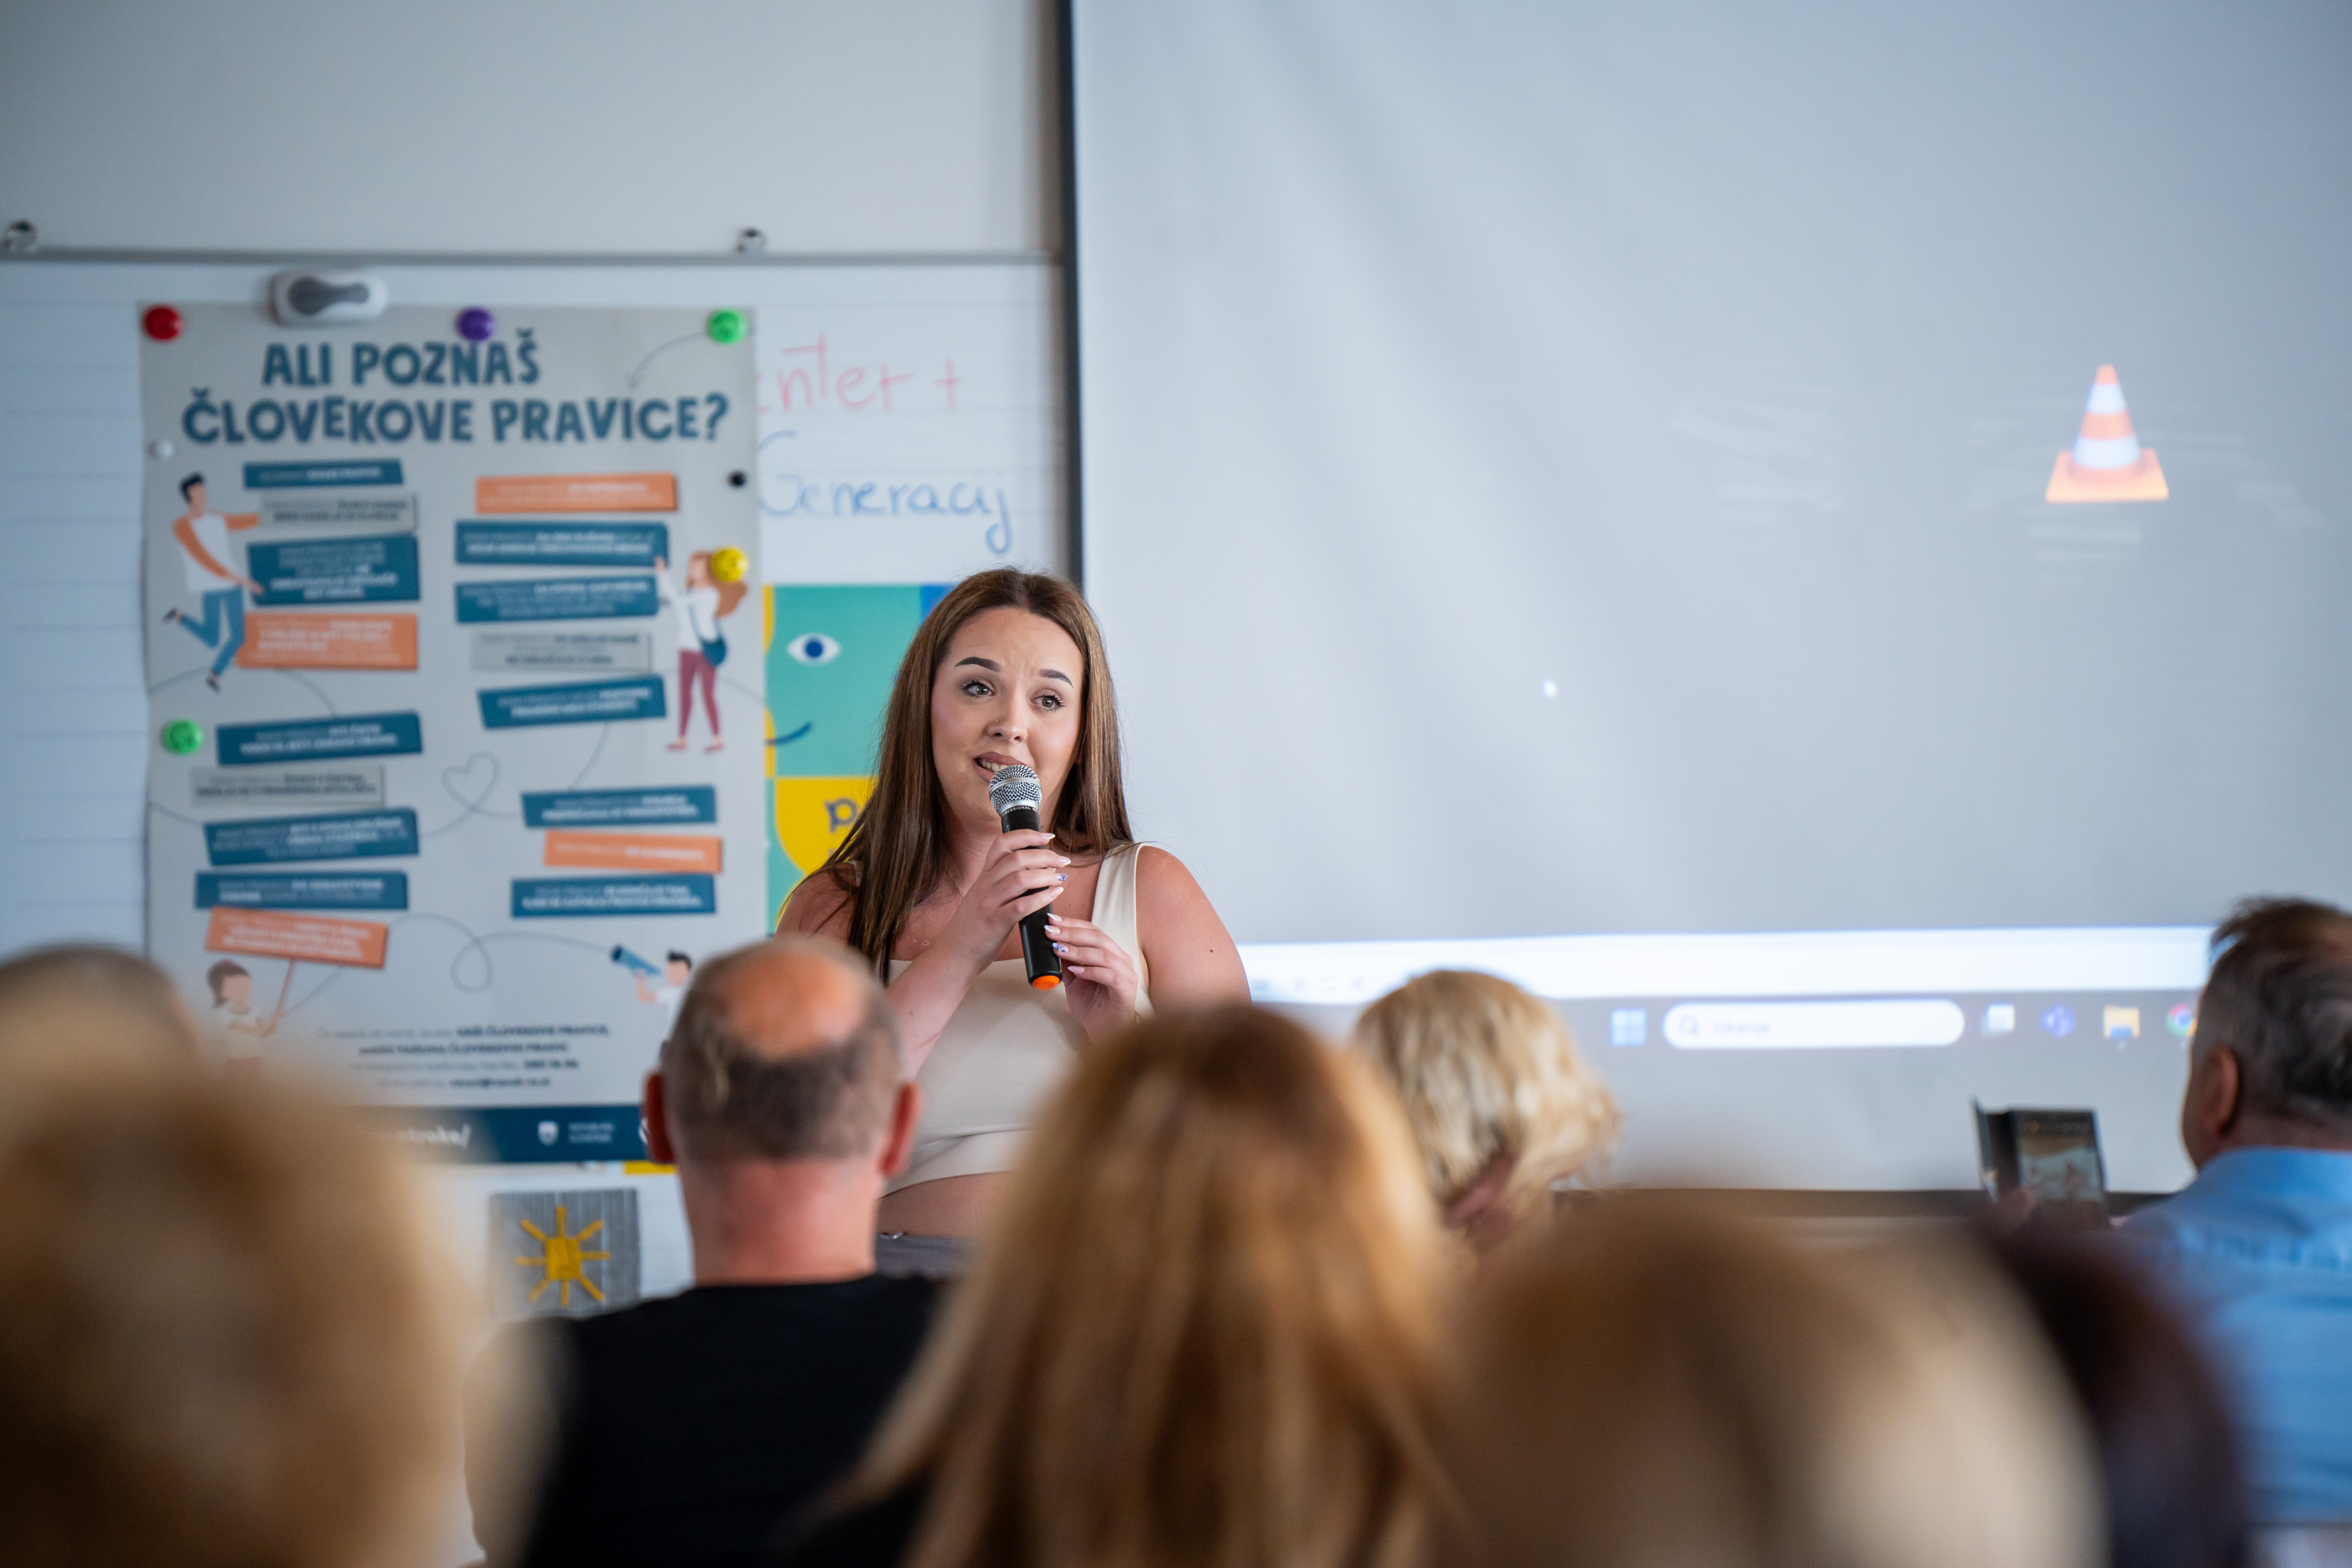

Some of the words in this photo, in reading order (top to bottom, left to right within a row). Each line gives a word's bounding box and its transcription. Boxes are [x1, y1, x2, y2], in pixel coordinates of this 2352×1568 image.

[262, 341, 332, 386] ALI
[351, 327, 541, 386] POZNAŠ
[756, 334, 913, 412] nter
[182, 388, 474, 444] ČLOVEKOVE
[491, 393, 729, 443] PRAVICE?
